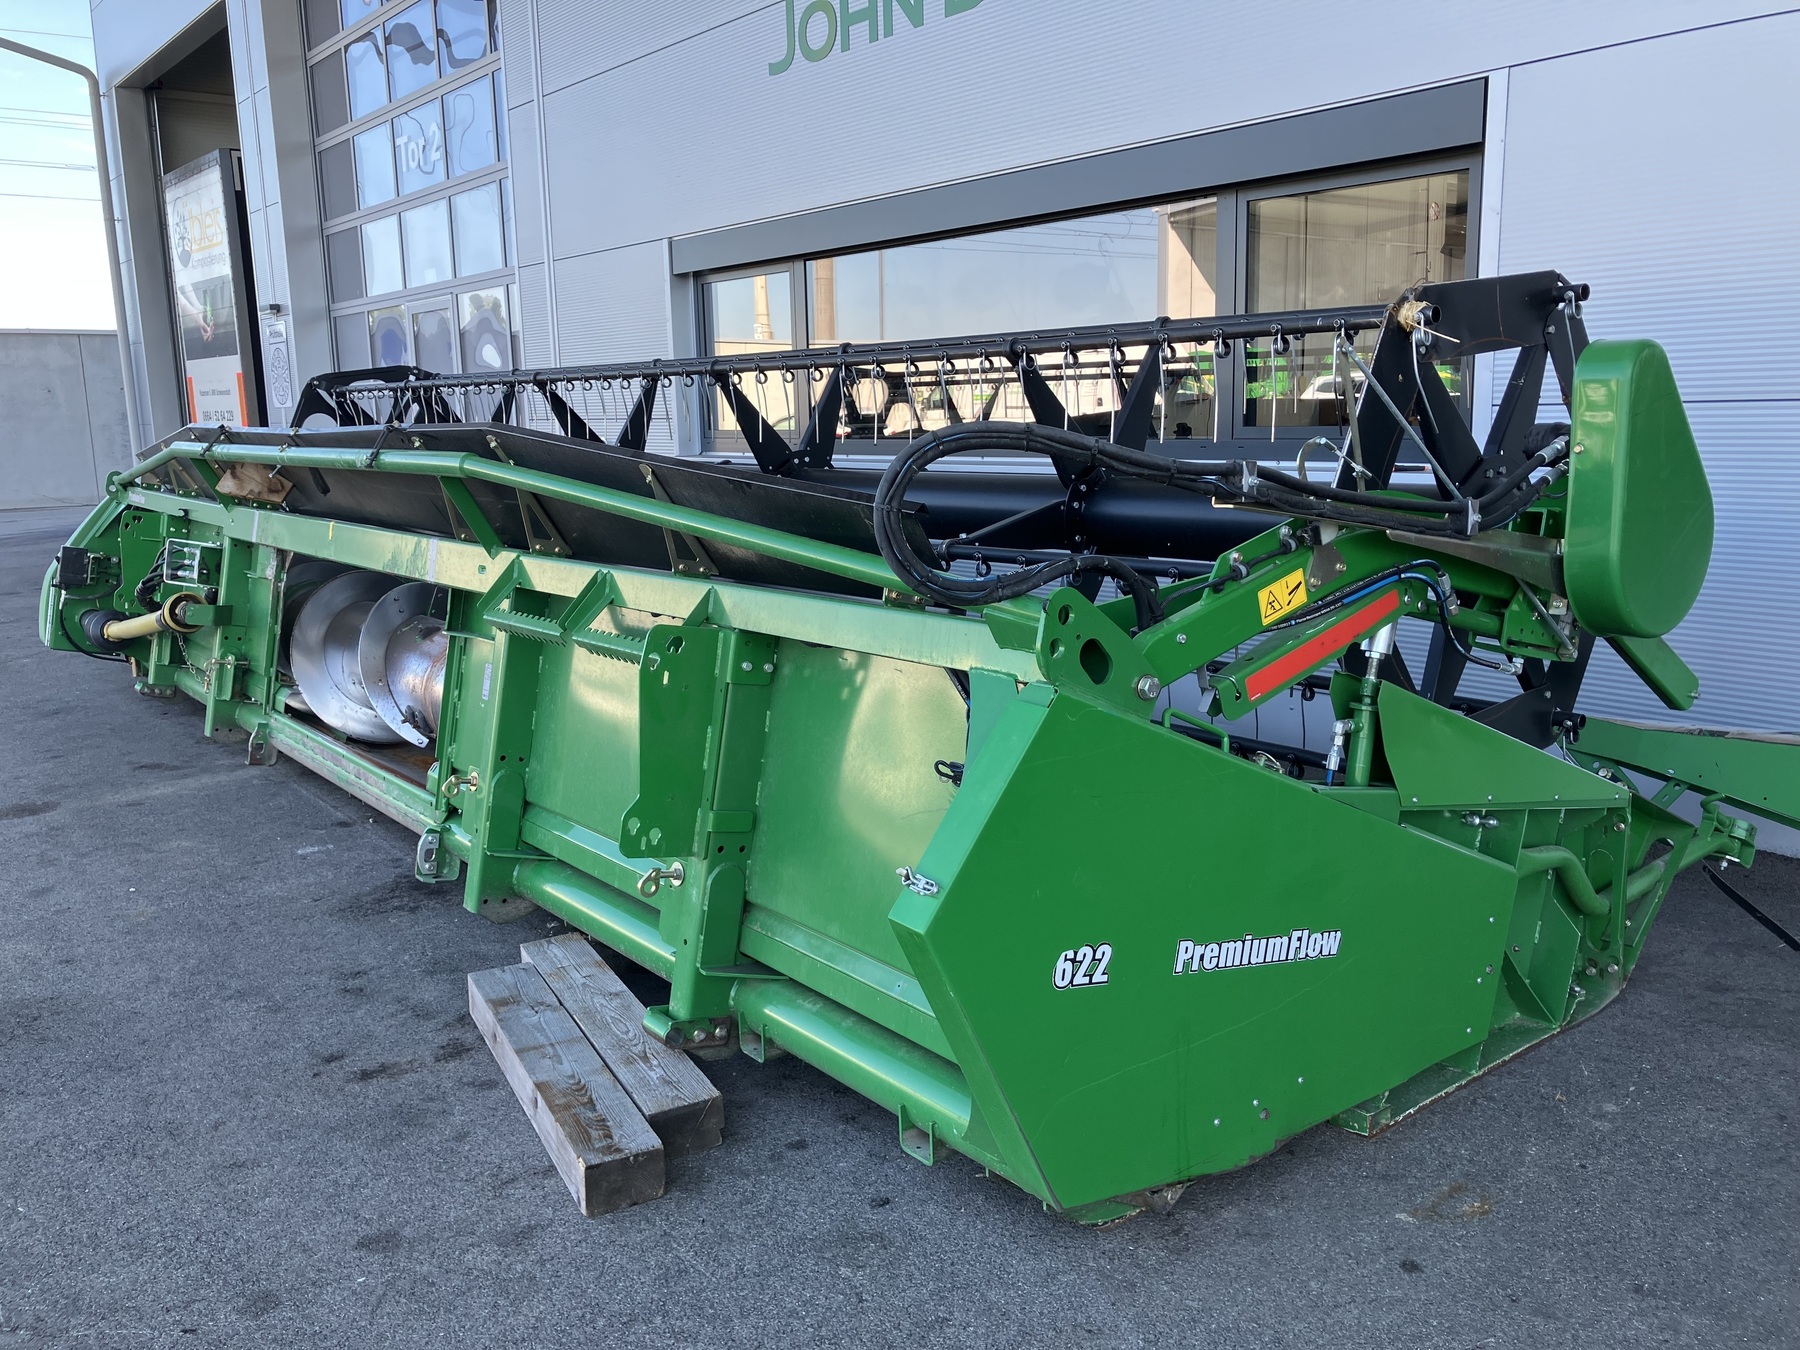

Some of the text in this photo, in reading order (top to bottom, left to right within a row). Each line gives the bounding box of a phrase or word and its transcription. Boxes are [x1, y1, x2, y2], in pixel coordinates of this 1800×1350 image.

[769, 0, 924, 76] JOHN
[396, 122, 441, 172] Tor 2
[214, 410, 220, 421] 52
[226, 410, 234, 421] 229
[1053, 942, 1112, 990] 622
[1173, 928, 1341, 975] PremiumFlow
